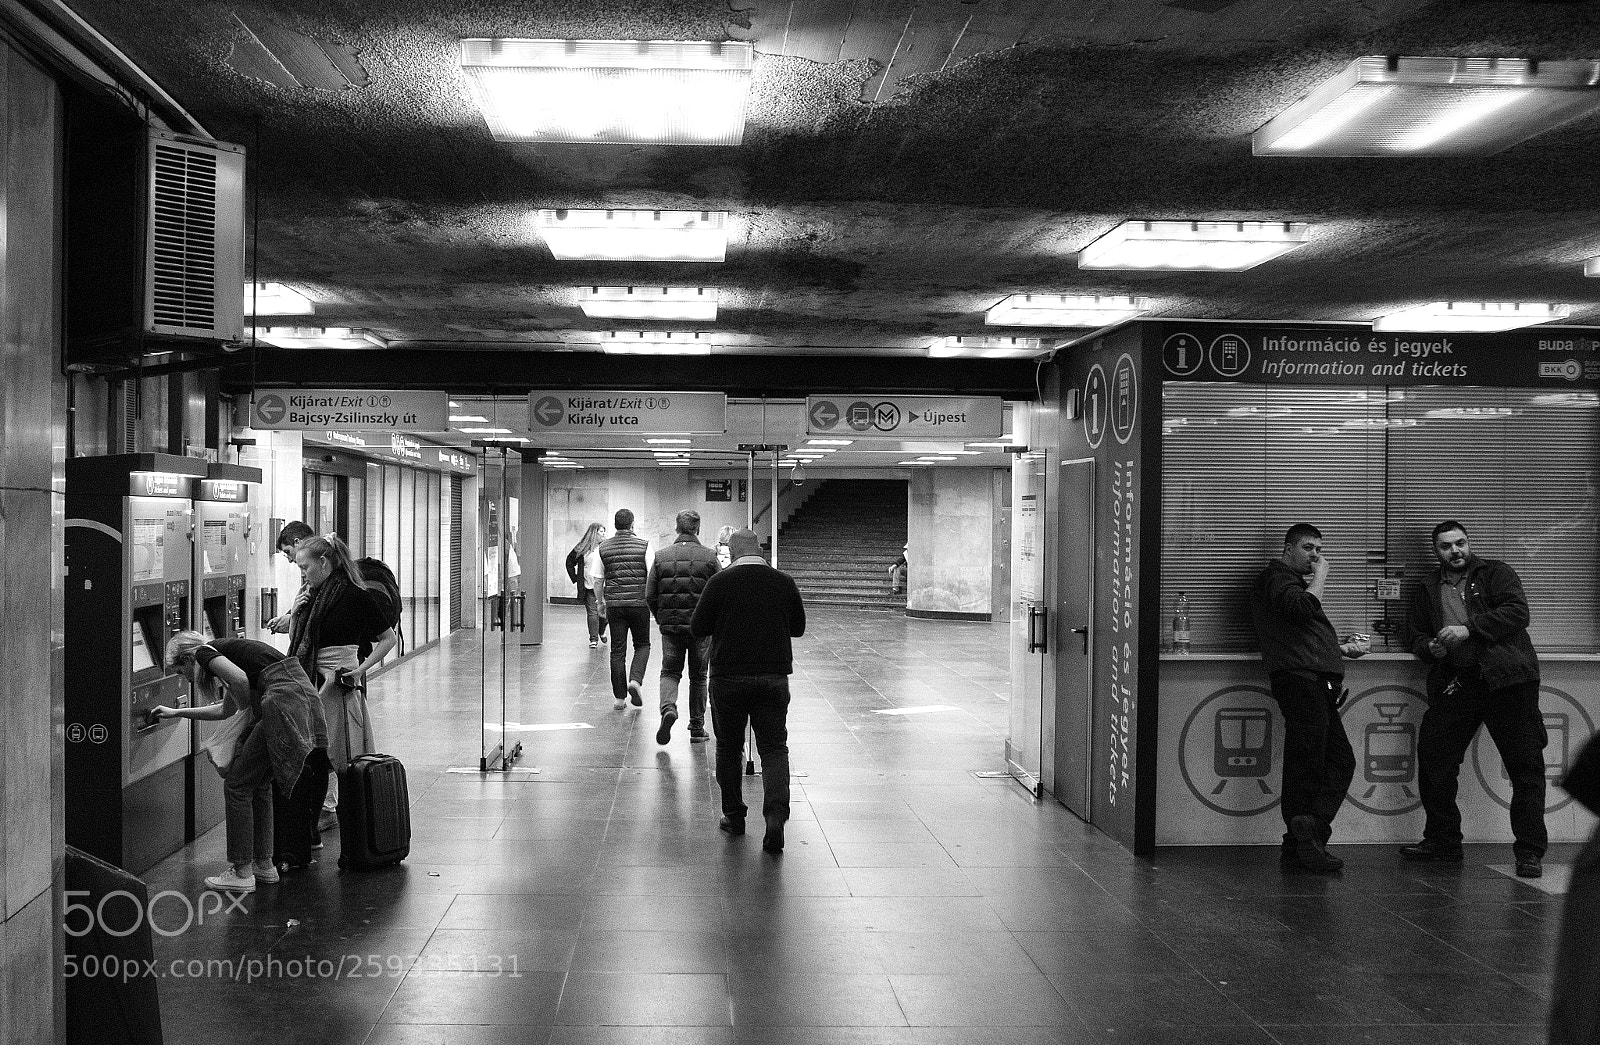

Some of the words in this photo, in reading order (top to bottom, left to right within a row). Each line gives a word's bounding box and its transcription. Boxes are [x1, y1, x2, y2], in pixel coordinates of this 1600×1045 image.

[1262, 336, 1361, 352] Információ
[1368, 338, 1387, 353] és
[1393, 338, 1453, 358] jegyek
[1261, 359, 1365, 378] Information
[1371, 361, 1406, 376] and
[1411, 361, 1468, 377] tickets
[290, 412, 399, 426] Bajcsy-Zsilinszky
[403, 412, 417, 424] út
[568, 413, 606, 427] Király
[610, 415, 639, 425] utca
[924, 409, 966, 426] Újpest
[1112, 461, 1123, 633] Information
[1124, 460, 1134, 629] Információ
[1123, 642, 1132, 674] és
[1111, 646, 1120, 703] and
[1120, 684, 1131, 788] jegyek
[1109, 713, 1119, 807] tickets
